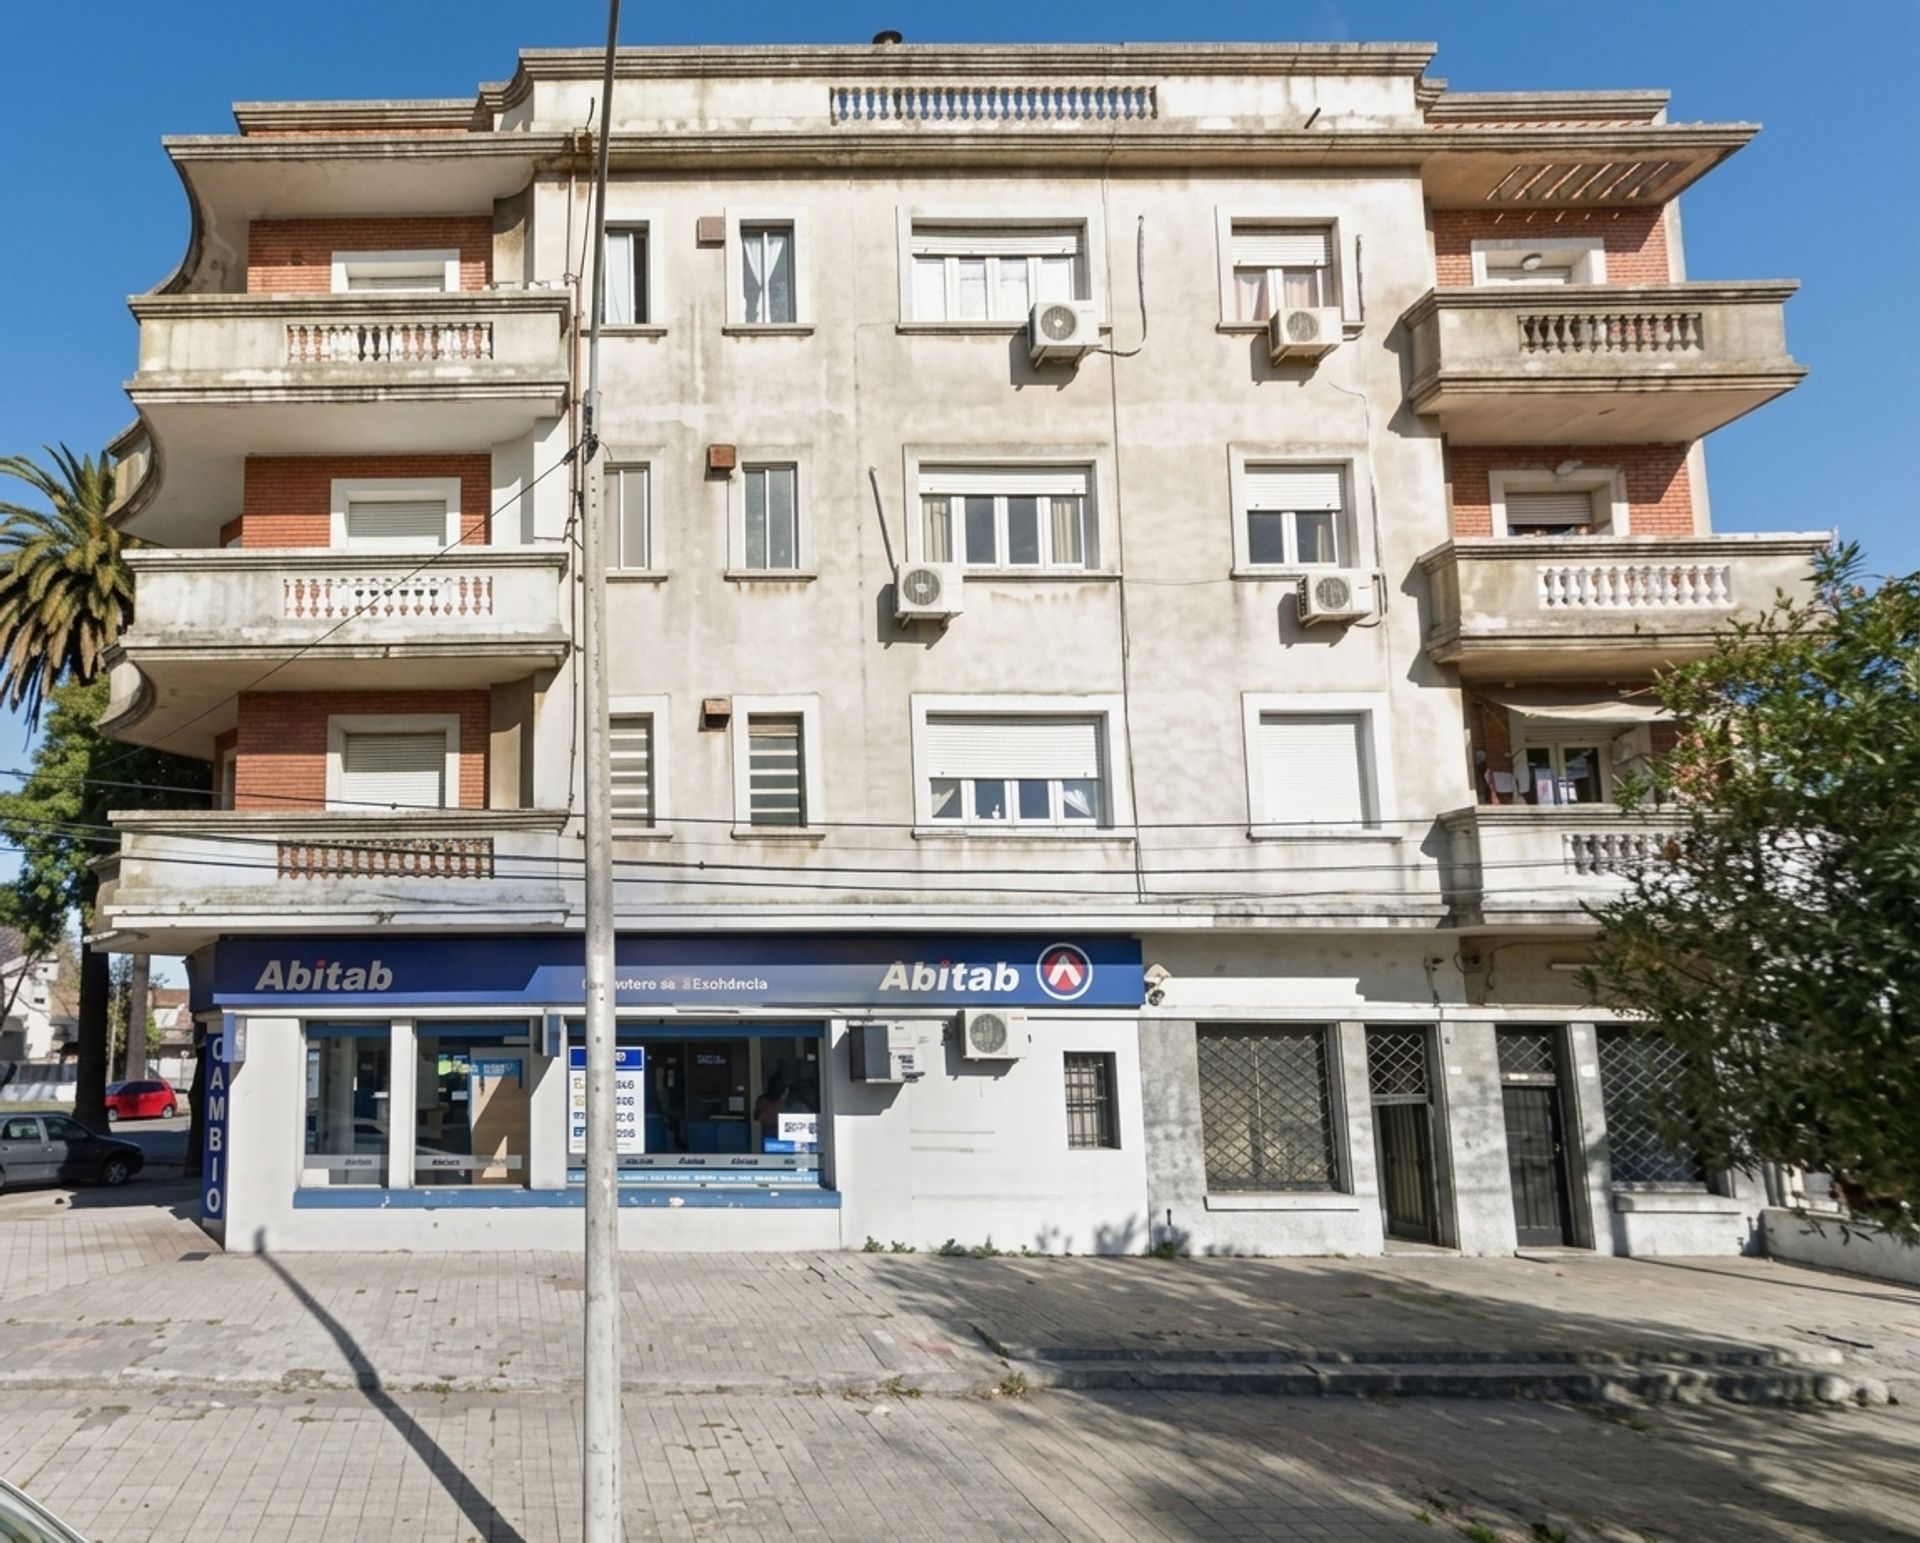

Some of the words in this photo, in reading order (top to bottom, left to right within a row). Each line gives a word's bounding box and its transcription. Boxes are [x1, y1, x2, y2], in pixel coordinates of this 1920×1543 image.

[254, 959, 394, 992] Abitab
[878, 959, 1020, 992] Abitab
[206, 1037, 225, 1213] CAMBIO
